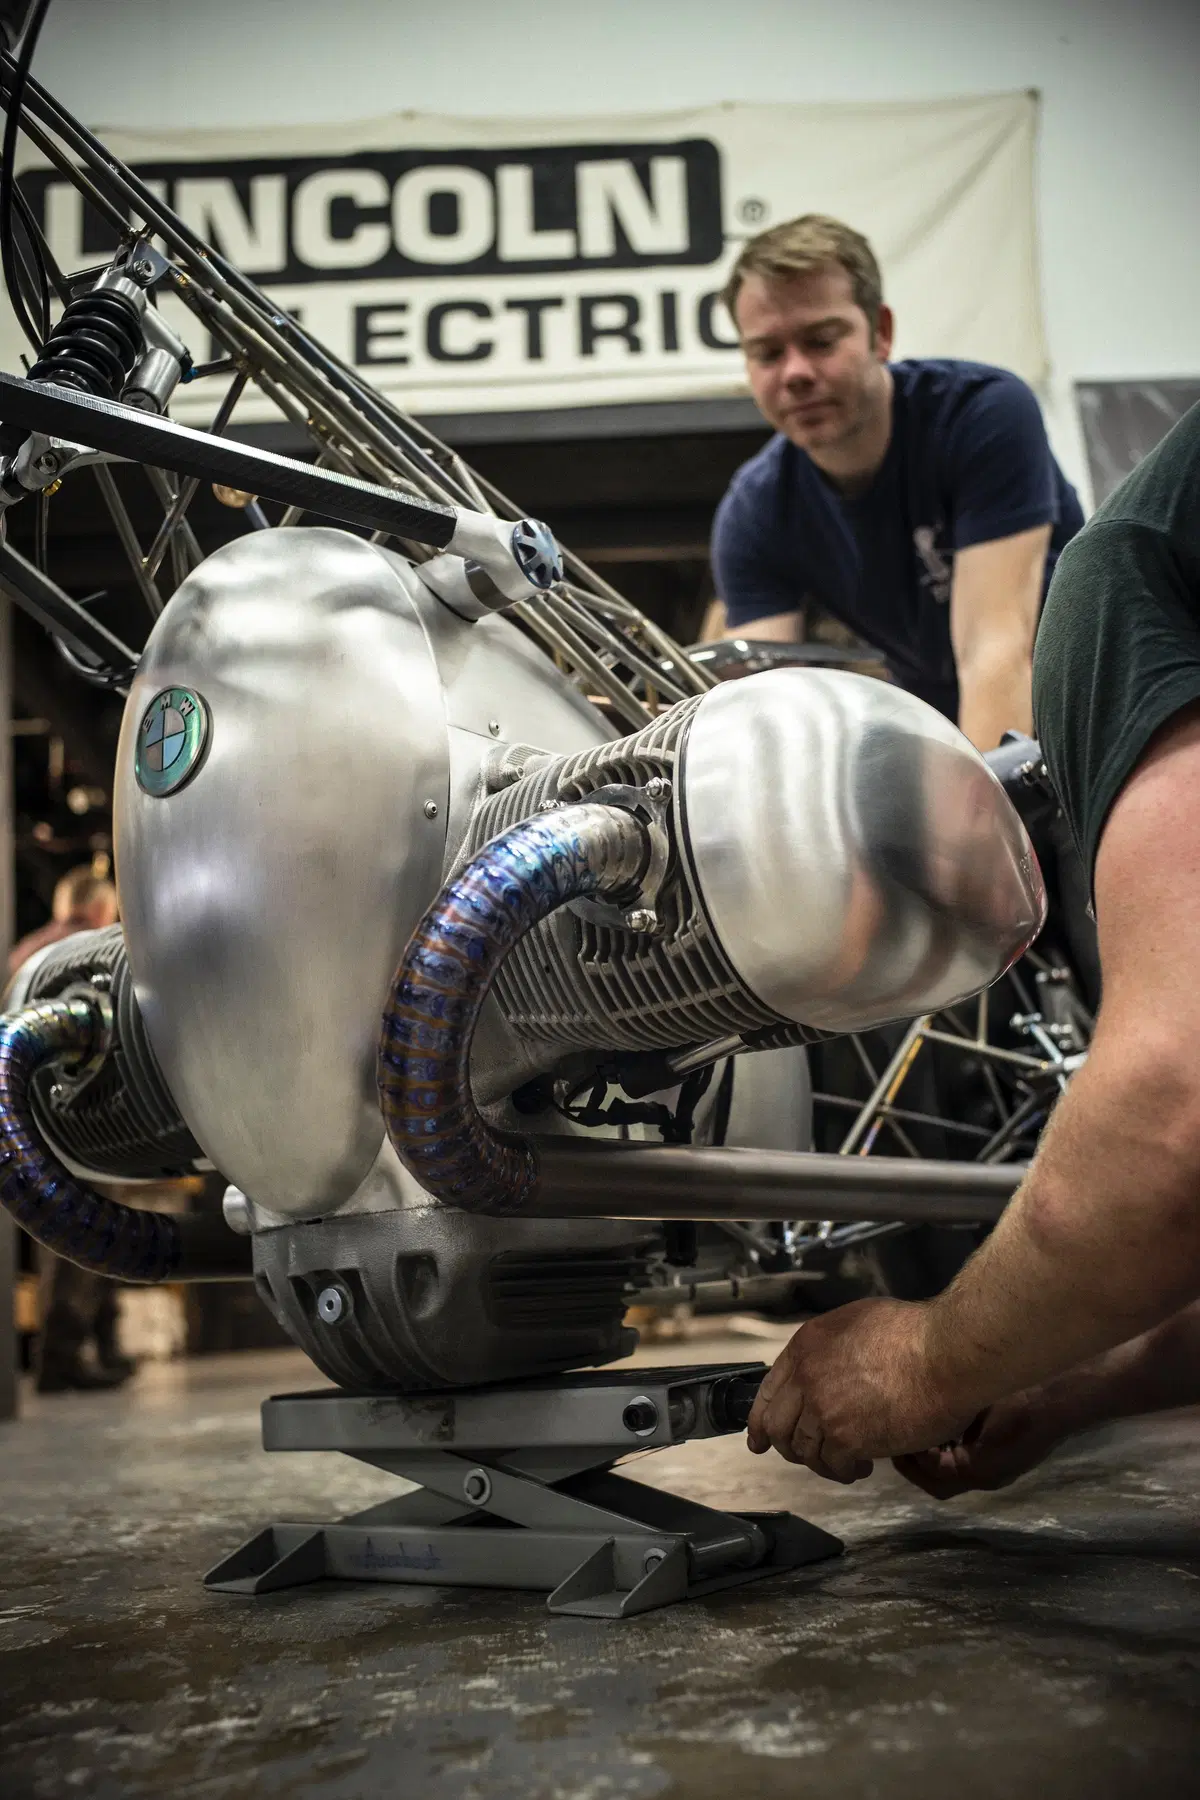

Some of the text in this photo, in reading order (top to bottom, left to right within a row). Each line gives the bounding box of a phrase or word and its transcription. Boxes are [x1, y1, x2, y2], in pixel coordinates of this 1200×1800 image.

[44, 155, 690, 274] LNCOLN
[211, 289, 741, 366] ECTRIC
[142, 693, 196, 733] BMW
